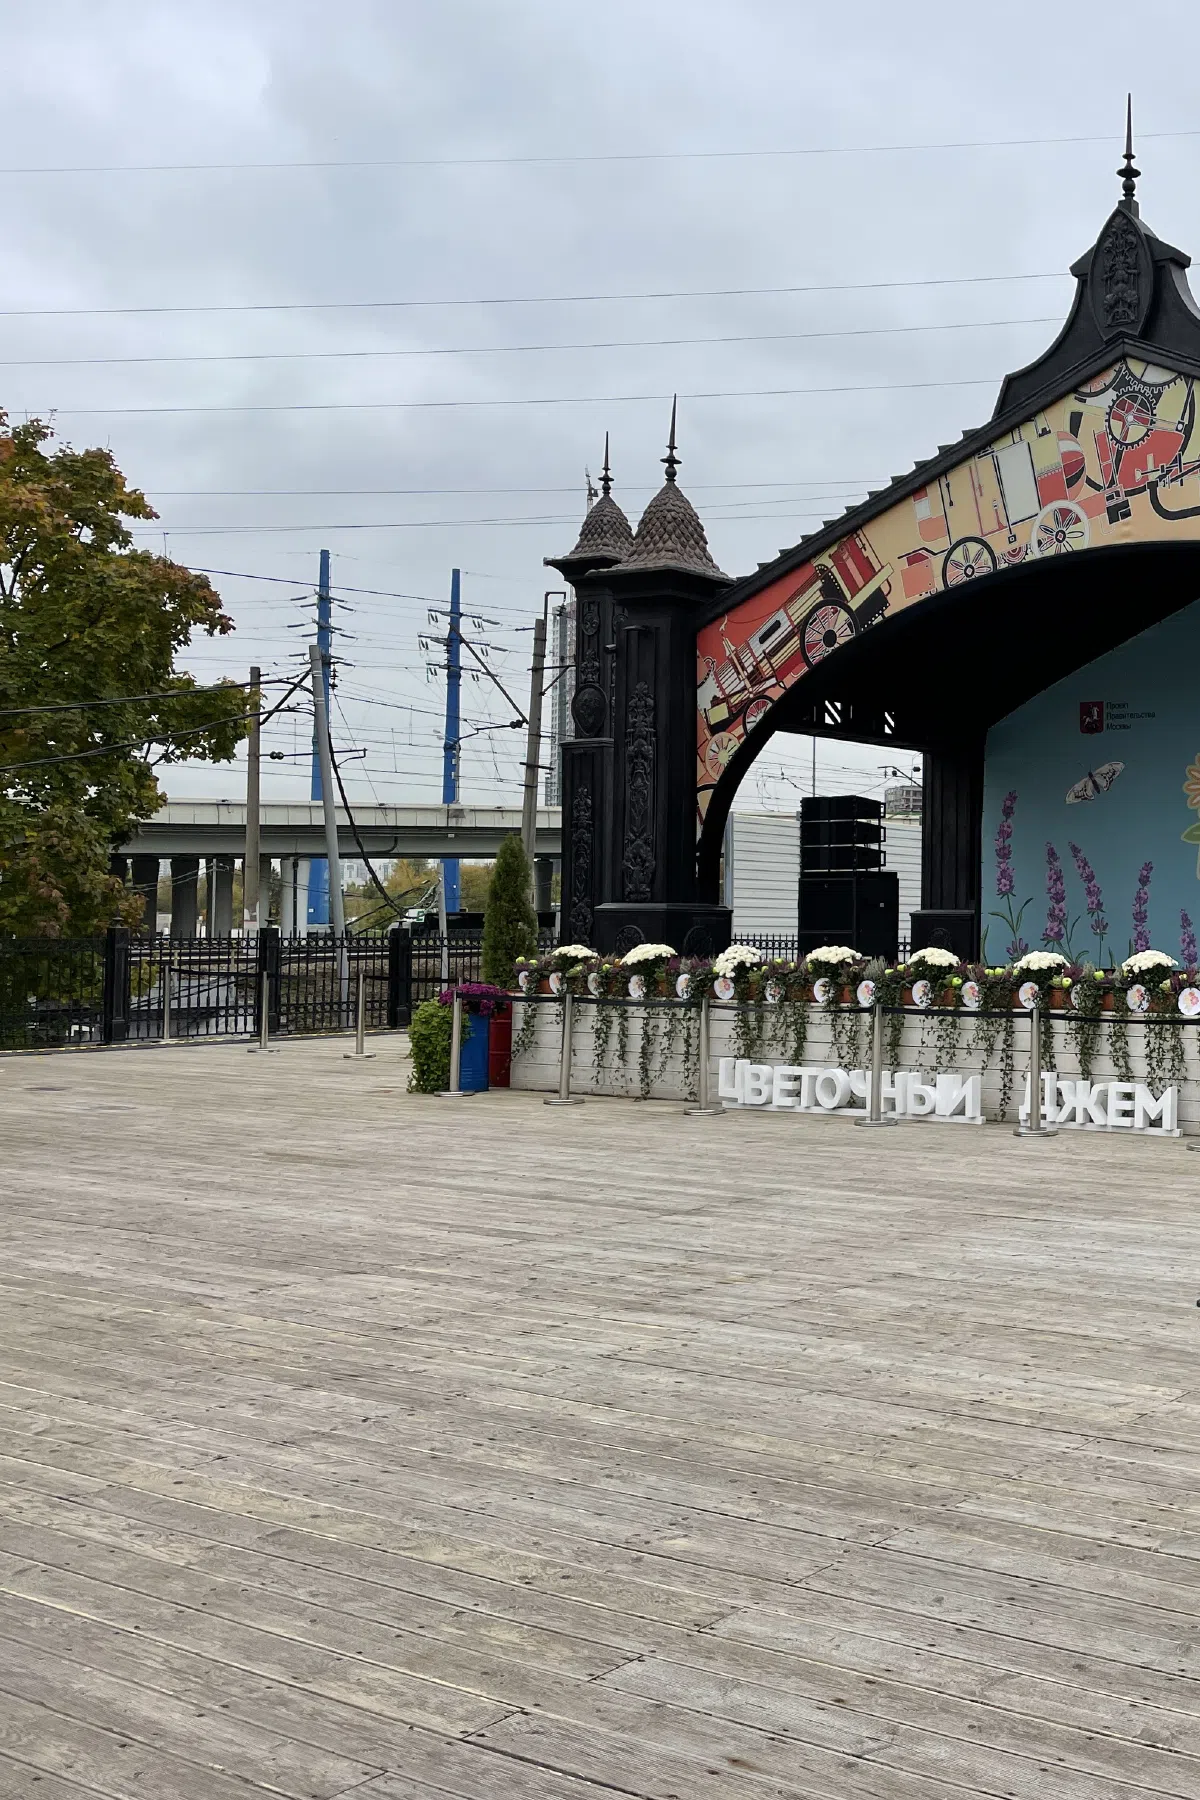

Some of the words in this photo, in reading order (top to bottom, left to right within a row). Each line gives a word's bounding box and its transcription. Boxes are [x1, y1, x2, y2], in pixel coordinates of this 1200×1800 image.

[1106, 711, 1156, 721] Правительства
[1106, 723, 1132, 731] Москвы
[1018, 1071, 1178, 1131] ДЖЕМ
